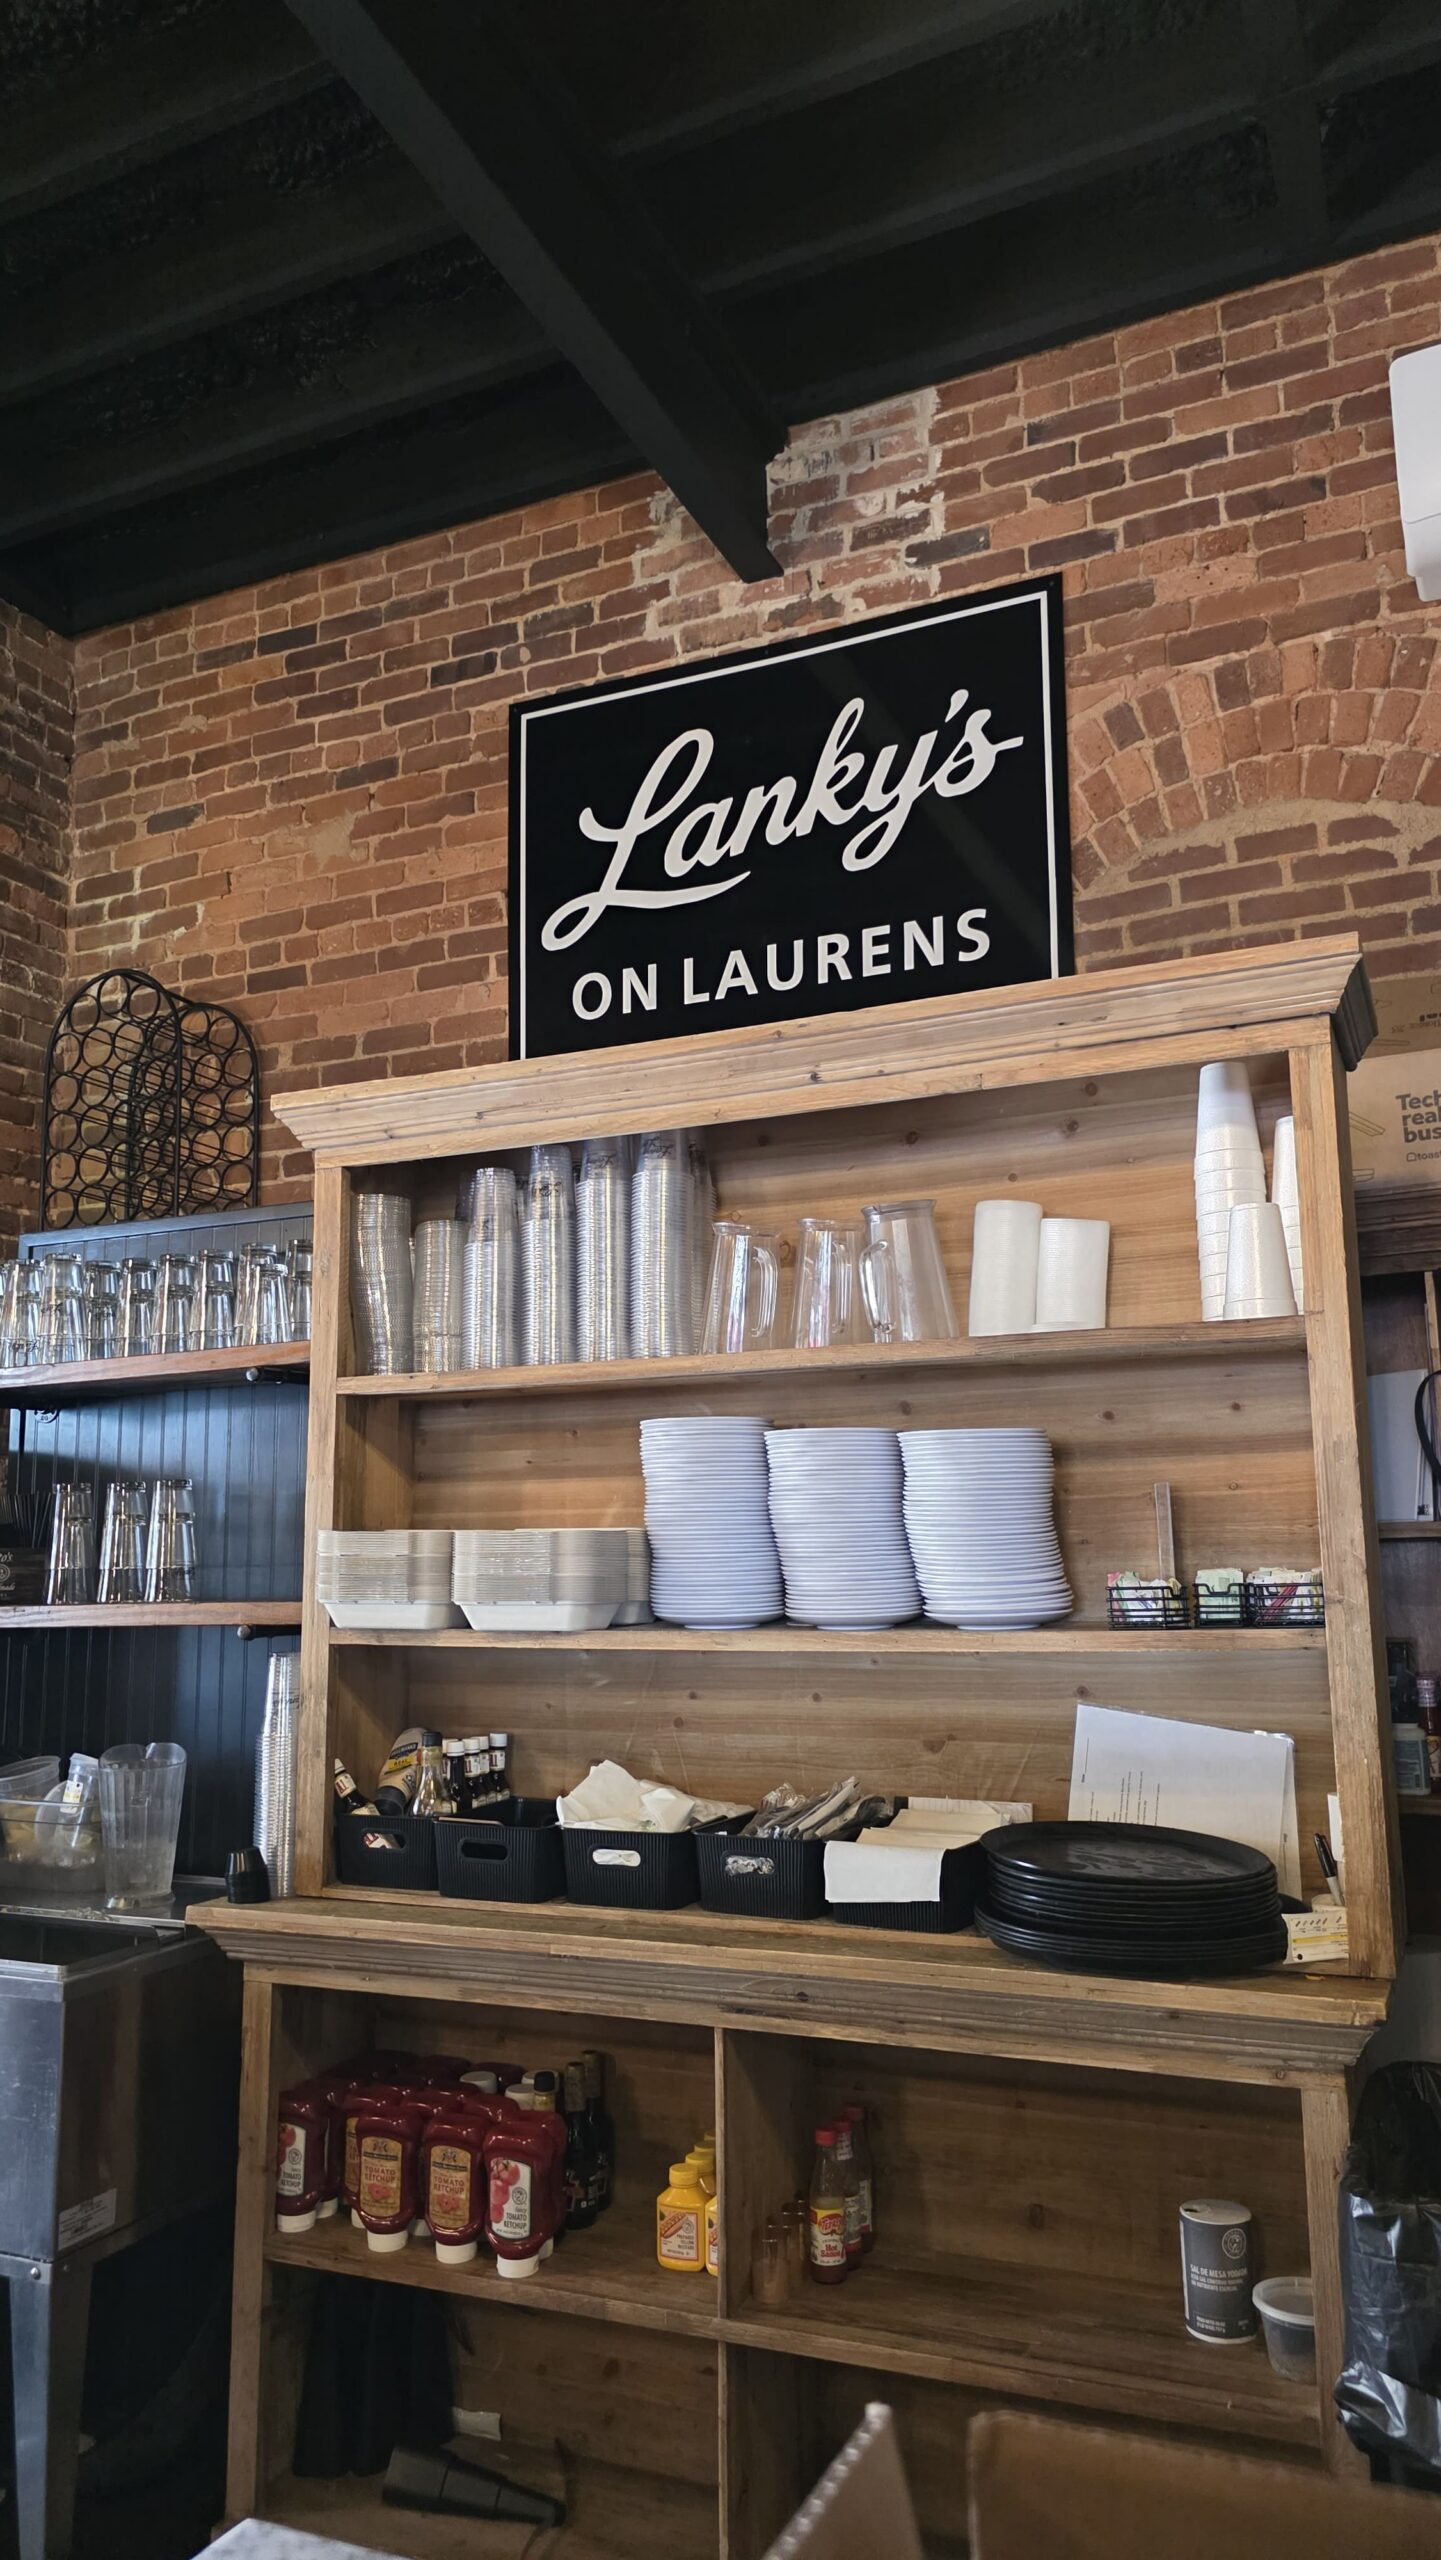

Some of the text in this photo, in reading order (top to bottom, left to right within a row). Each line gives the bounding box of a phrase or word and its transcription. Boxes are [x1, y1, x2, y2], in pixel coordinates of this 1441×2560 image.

[541, 689, 1023, 951] Lanky's
[572, 908, 991, 1020] ON LAURENS
[365, 2165, 397, 2177] TOMATO
[365, 2173, 396, 2184] KETCHUP
[434, 2176, 465, 2187] TOMATO
[434, 2183, 465, 2195] KETCHUP
[506, 2212, 527, 2222] TOMATO
[503, 2220, 527, 2230] KETCHUP
[1190, 2264, 1200, 2275] SAL
[1200, 2267, 1208, 2277] DE
[1209, 2269, 1226, 2279] MESA
